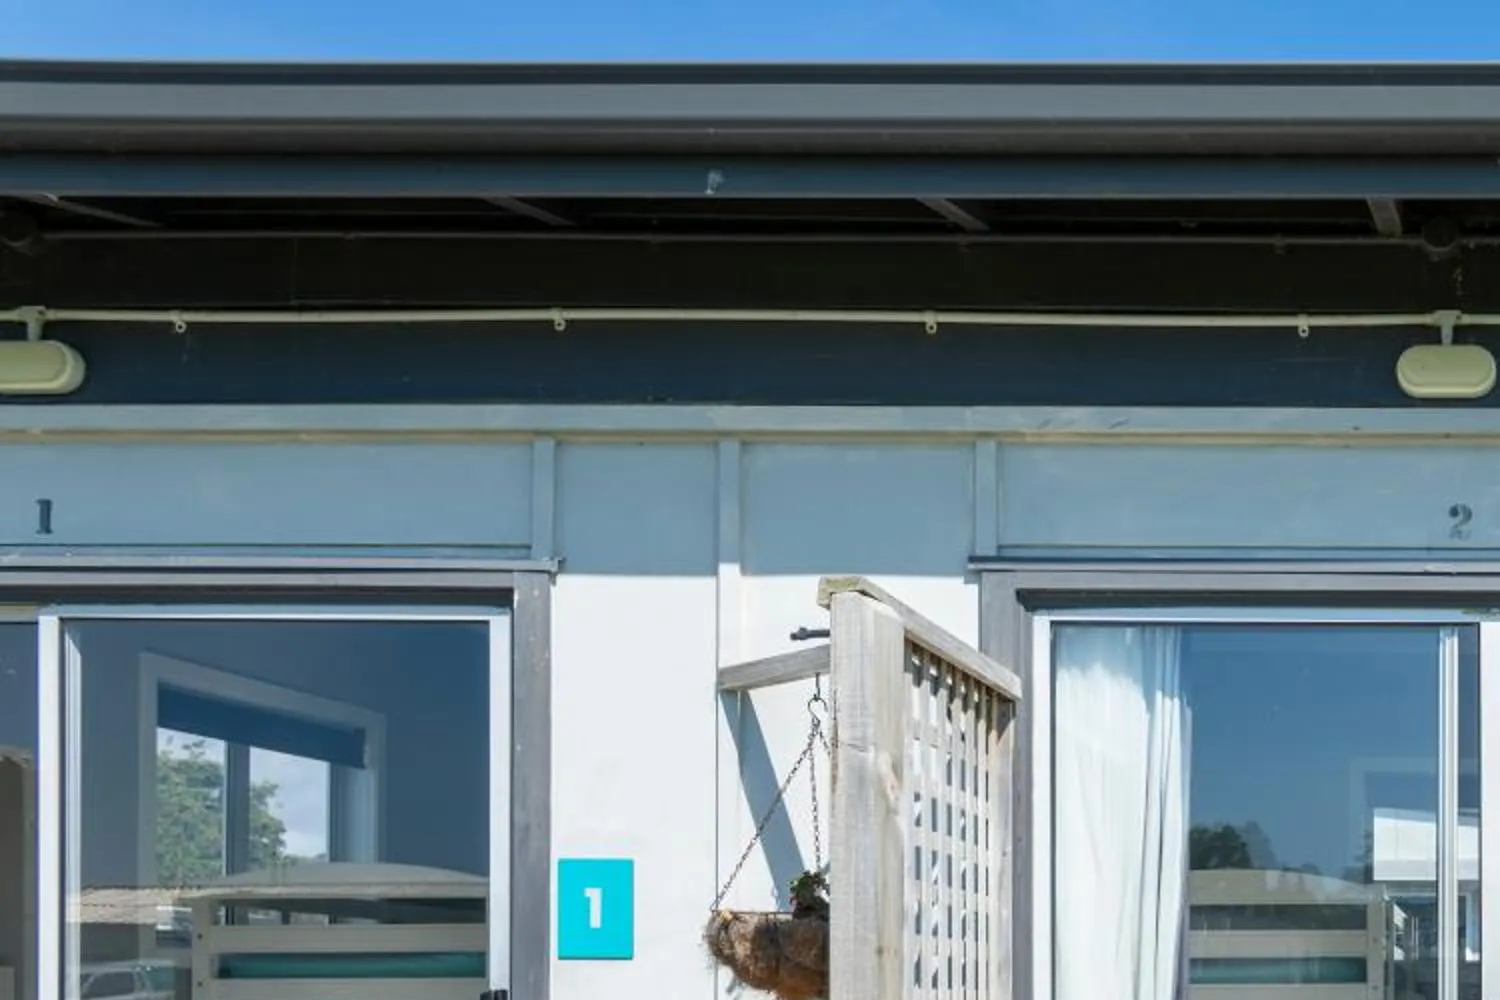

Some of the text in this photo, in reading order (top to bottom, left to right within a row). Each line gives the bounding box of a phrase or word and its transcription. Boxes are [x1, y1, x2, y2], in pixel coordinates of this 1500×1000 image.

[35, 498, 54, 535] 1
[1448, 502, 1473, 540] 2
[584, 887, 603, 929] 1
